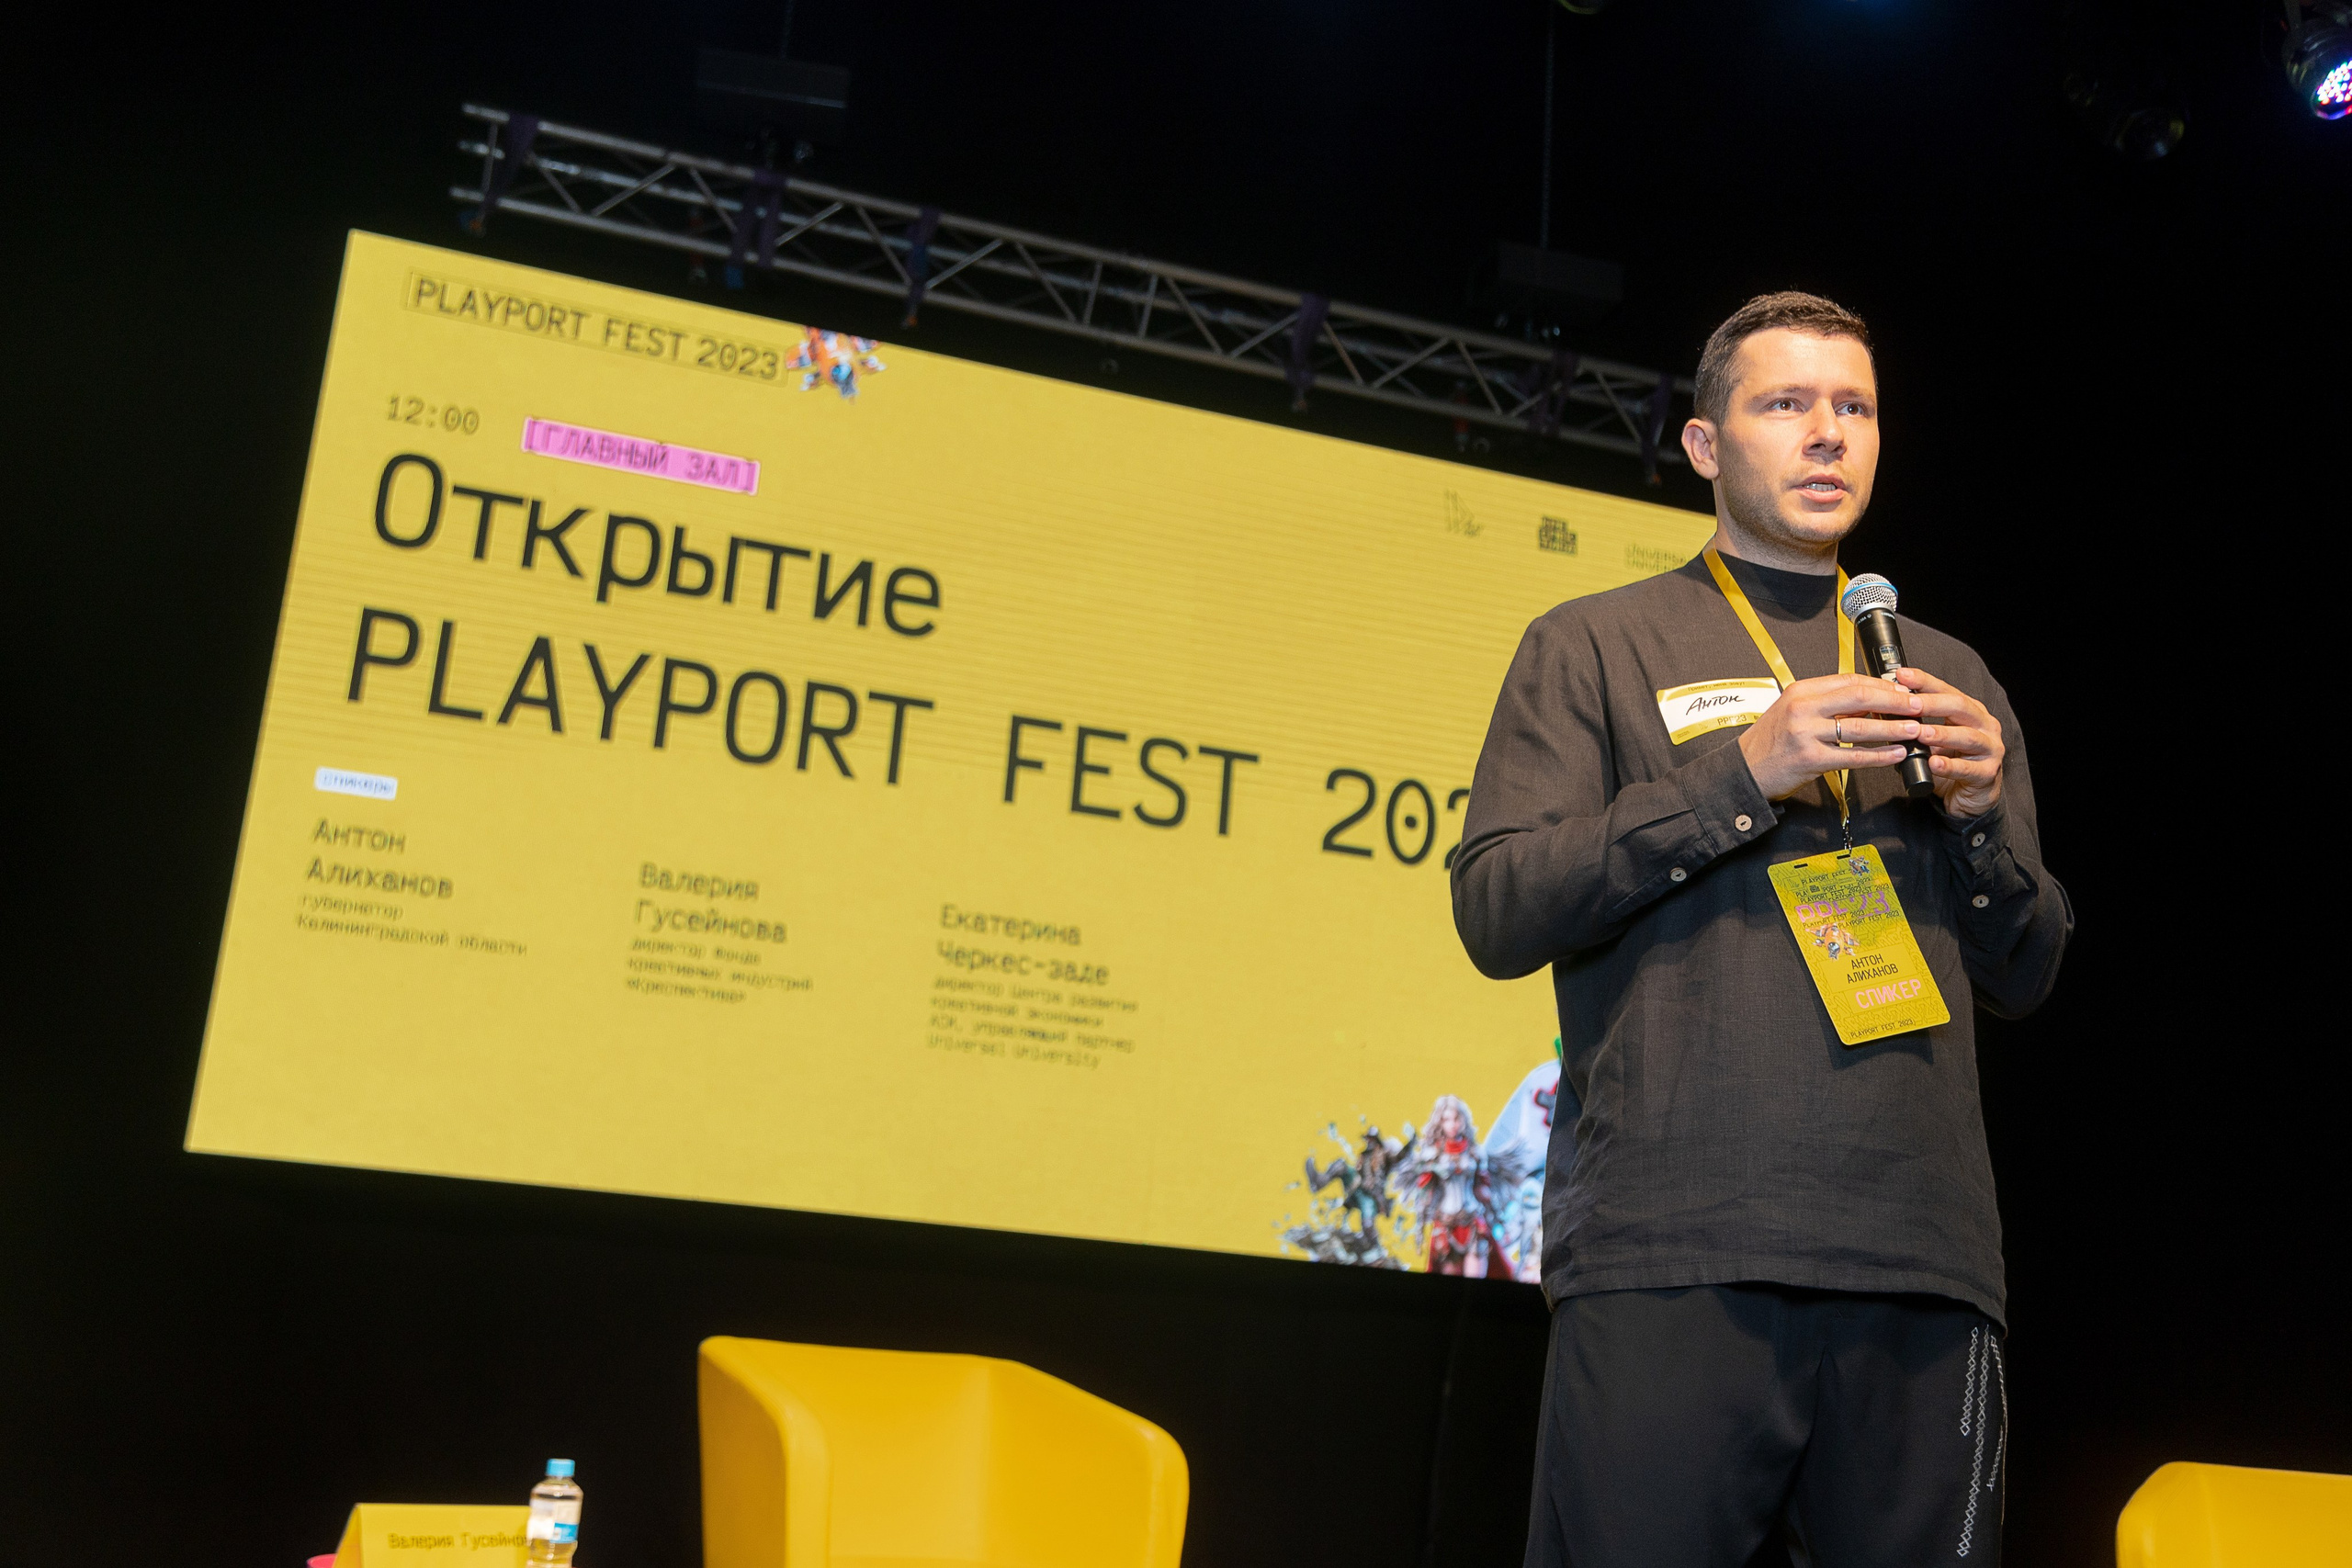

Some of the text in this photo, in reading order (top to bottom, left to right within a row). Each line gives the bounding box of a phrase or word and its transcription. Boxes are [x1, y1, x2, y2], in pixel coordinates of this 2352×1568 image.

[414, 277, 779, 380] PLAYPORT FEST 2023
[386, 395, 479, 435] 12:00
[374, 454, 941, 637] Открытие
[346, 607, 934, 784] PLAYPORT
[1002, 715, 1260, 837] FEST
[314, 817, 406, 853] Антон
[308, 856, 454, 898] Алиханов
[640, 863, 760, 900] Валерия
[1800, 894, 1828, 904] PLAYPORT
[1831, 889, 1845, 897] FEST
[636, 899, 787, 943] Гусейнова
[942, 903, 1081, 945] Екатерина
[1833, 913, 1848, 922] FEST
[1850, 909, 1865, 918] 2023
[1838, 910, 1900, 929] PLAYPORT FEST 2023
[938, 941, 1109, 986] Черкес-заде
[1847, 963, 1899, 984] АЛИХАНОВ
[1851, 953, 1884, 969] АНТОН
[1855, 978, 1921, 1009] СПИКЕР
[1850, 1026, 1879, 1039] PLAYPORT
[1881, 1022, 1896, 1031] FEST
[388, 1532, 454, 1551] Валерия
